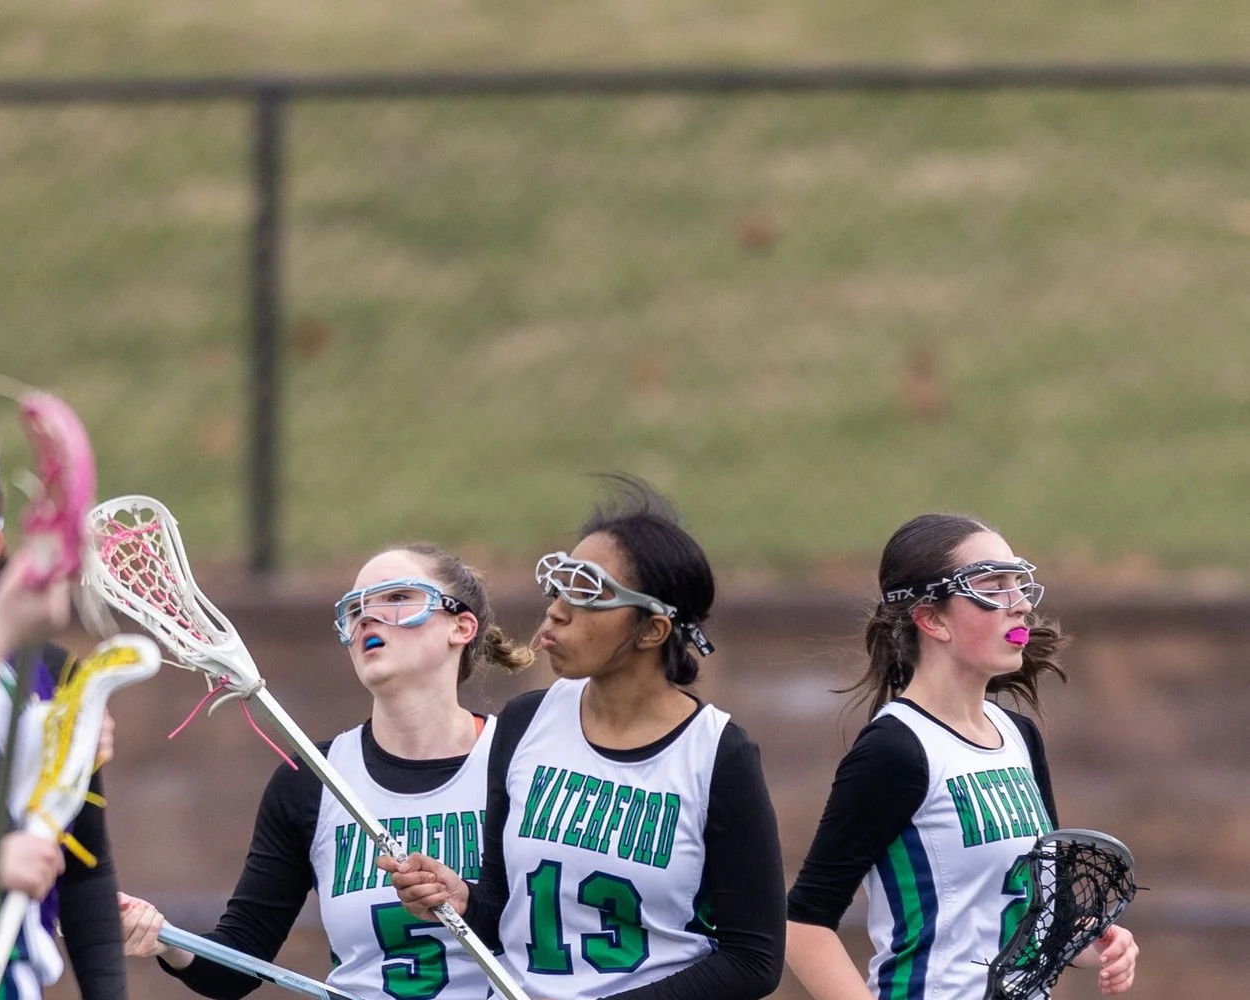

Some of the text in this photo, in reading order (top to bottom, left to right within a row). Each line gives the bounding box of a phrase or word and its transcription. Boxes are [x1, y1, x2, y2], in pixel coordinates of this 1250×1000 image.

[442, 596, 461, 613] TX
[887, 587, 915, 602] STX
[331, 810, 486, 898] WATERFOR
[517, 765, 681, 869] WATERFORD
[526, 859, 650, 975] 13
